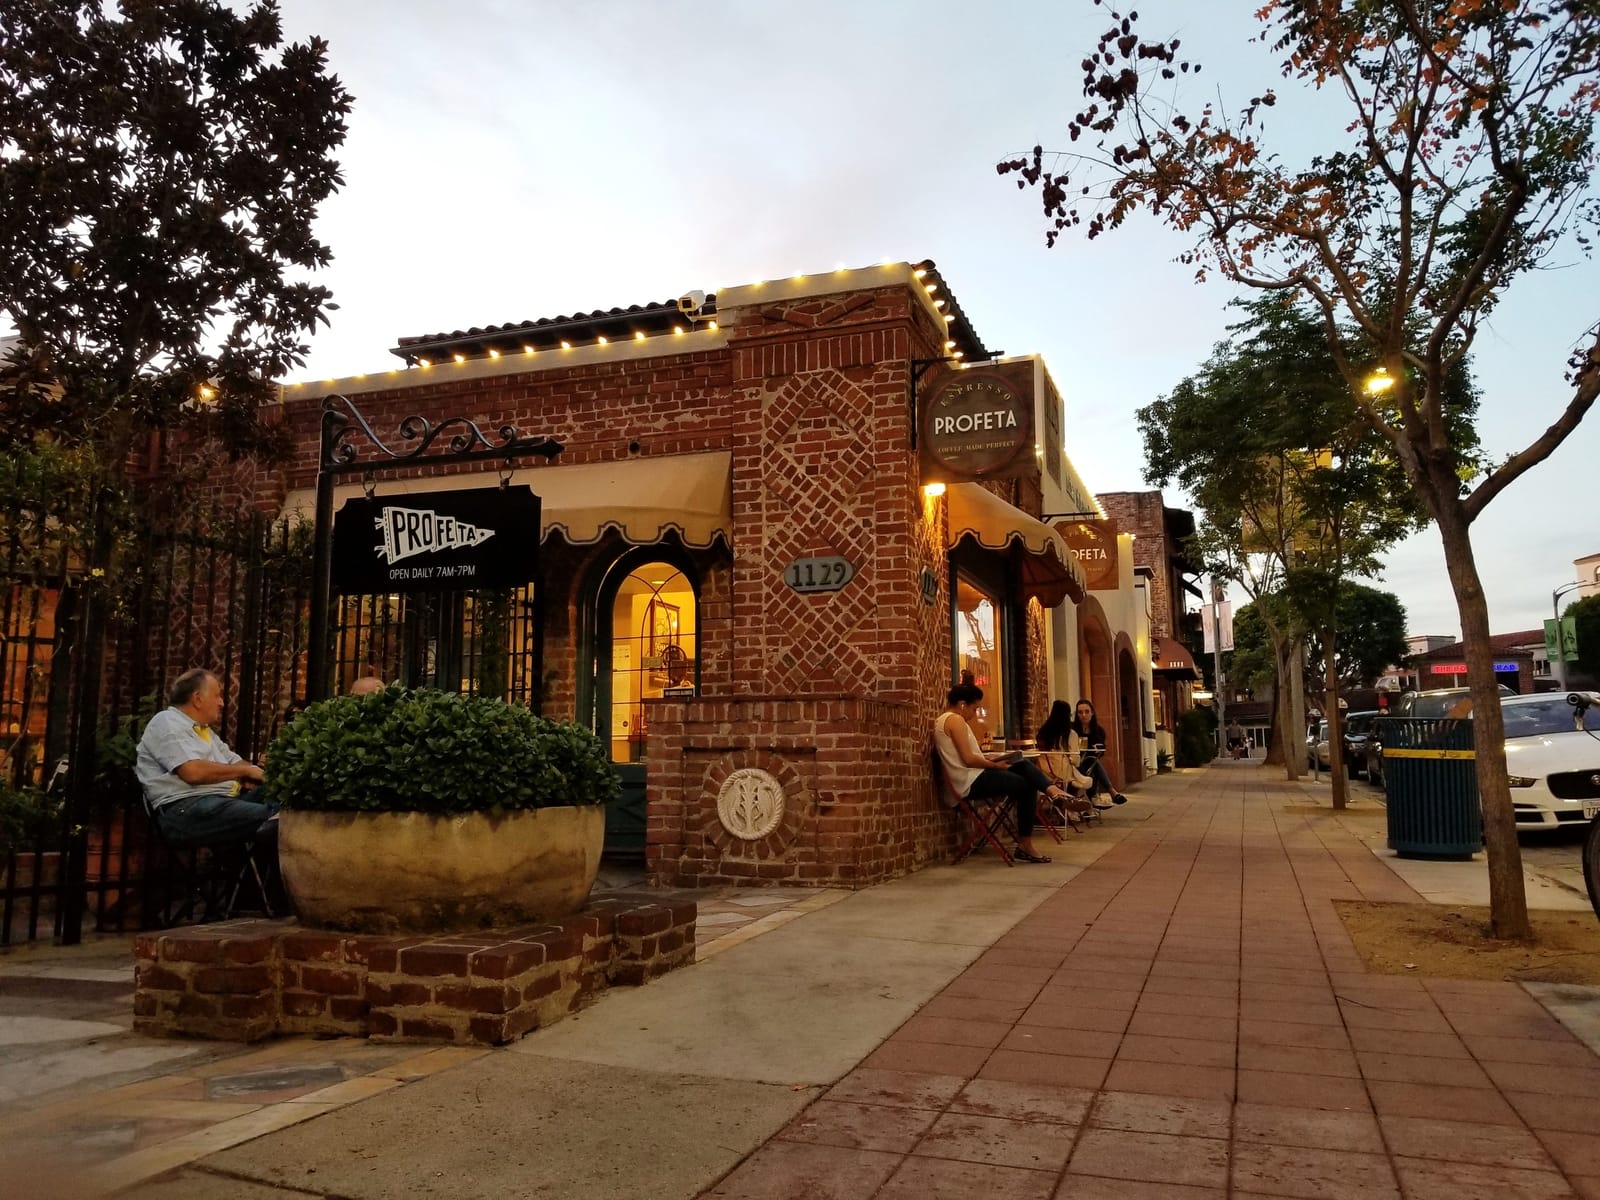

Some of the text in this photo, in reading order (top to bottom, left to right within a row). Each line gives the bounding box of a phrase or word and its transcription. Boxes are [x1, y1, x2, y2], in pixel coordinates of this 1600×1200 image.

[940, 382, 1012, 407] ESPRESSO
[934, 409, 1017, 435] PROFETA
[391, 510, 476, 556] PROFETA
[1070, 548, 1107, 560] OFETA
[389, 565, 476, 579] OPEN DAILY 7AM-7PM
[792, 562, 847, 587] 1129
